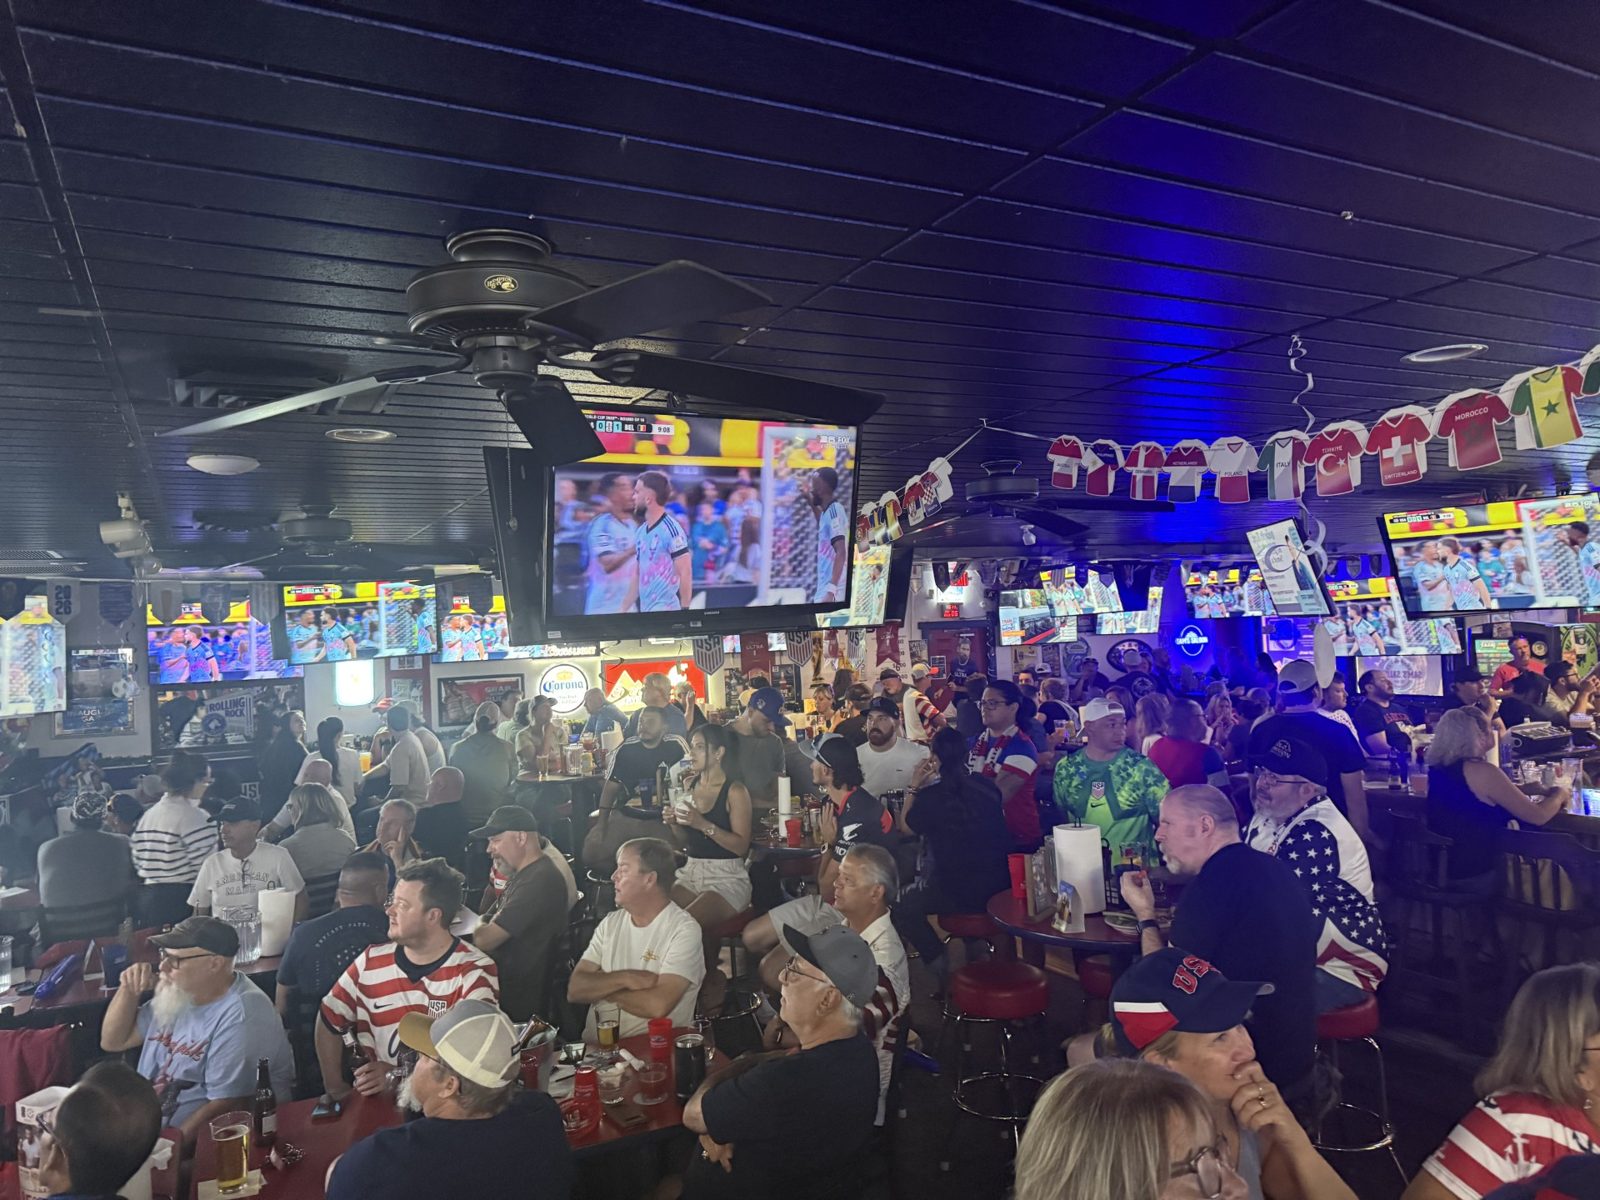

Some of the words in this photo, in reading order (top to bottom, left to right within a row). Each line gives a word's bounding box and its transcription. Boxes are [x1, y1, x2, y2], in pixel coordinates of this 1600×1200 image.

[1455, 407, 1489, 421] MOROCCO
[624, 423, 635, 431] BEL
[1384, 470, 1418, 480] SWITZERLAND
[55, 585, 71, 600] 20
[55, 600, 72, 615] 26
[695, 634, 721, 651] USA
[543, 681, 584, 692] Corona
[209, 697, 246, 712] ROLLING
[225, 709, 246, 717] ROCK
[216, 871, 270, 888] AMERCAN
